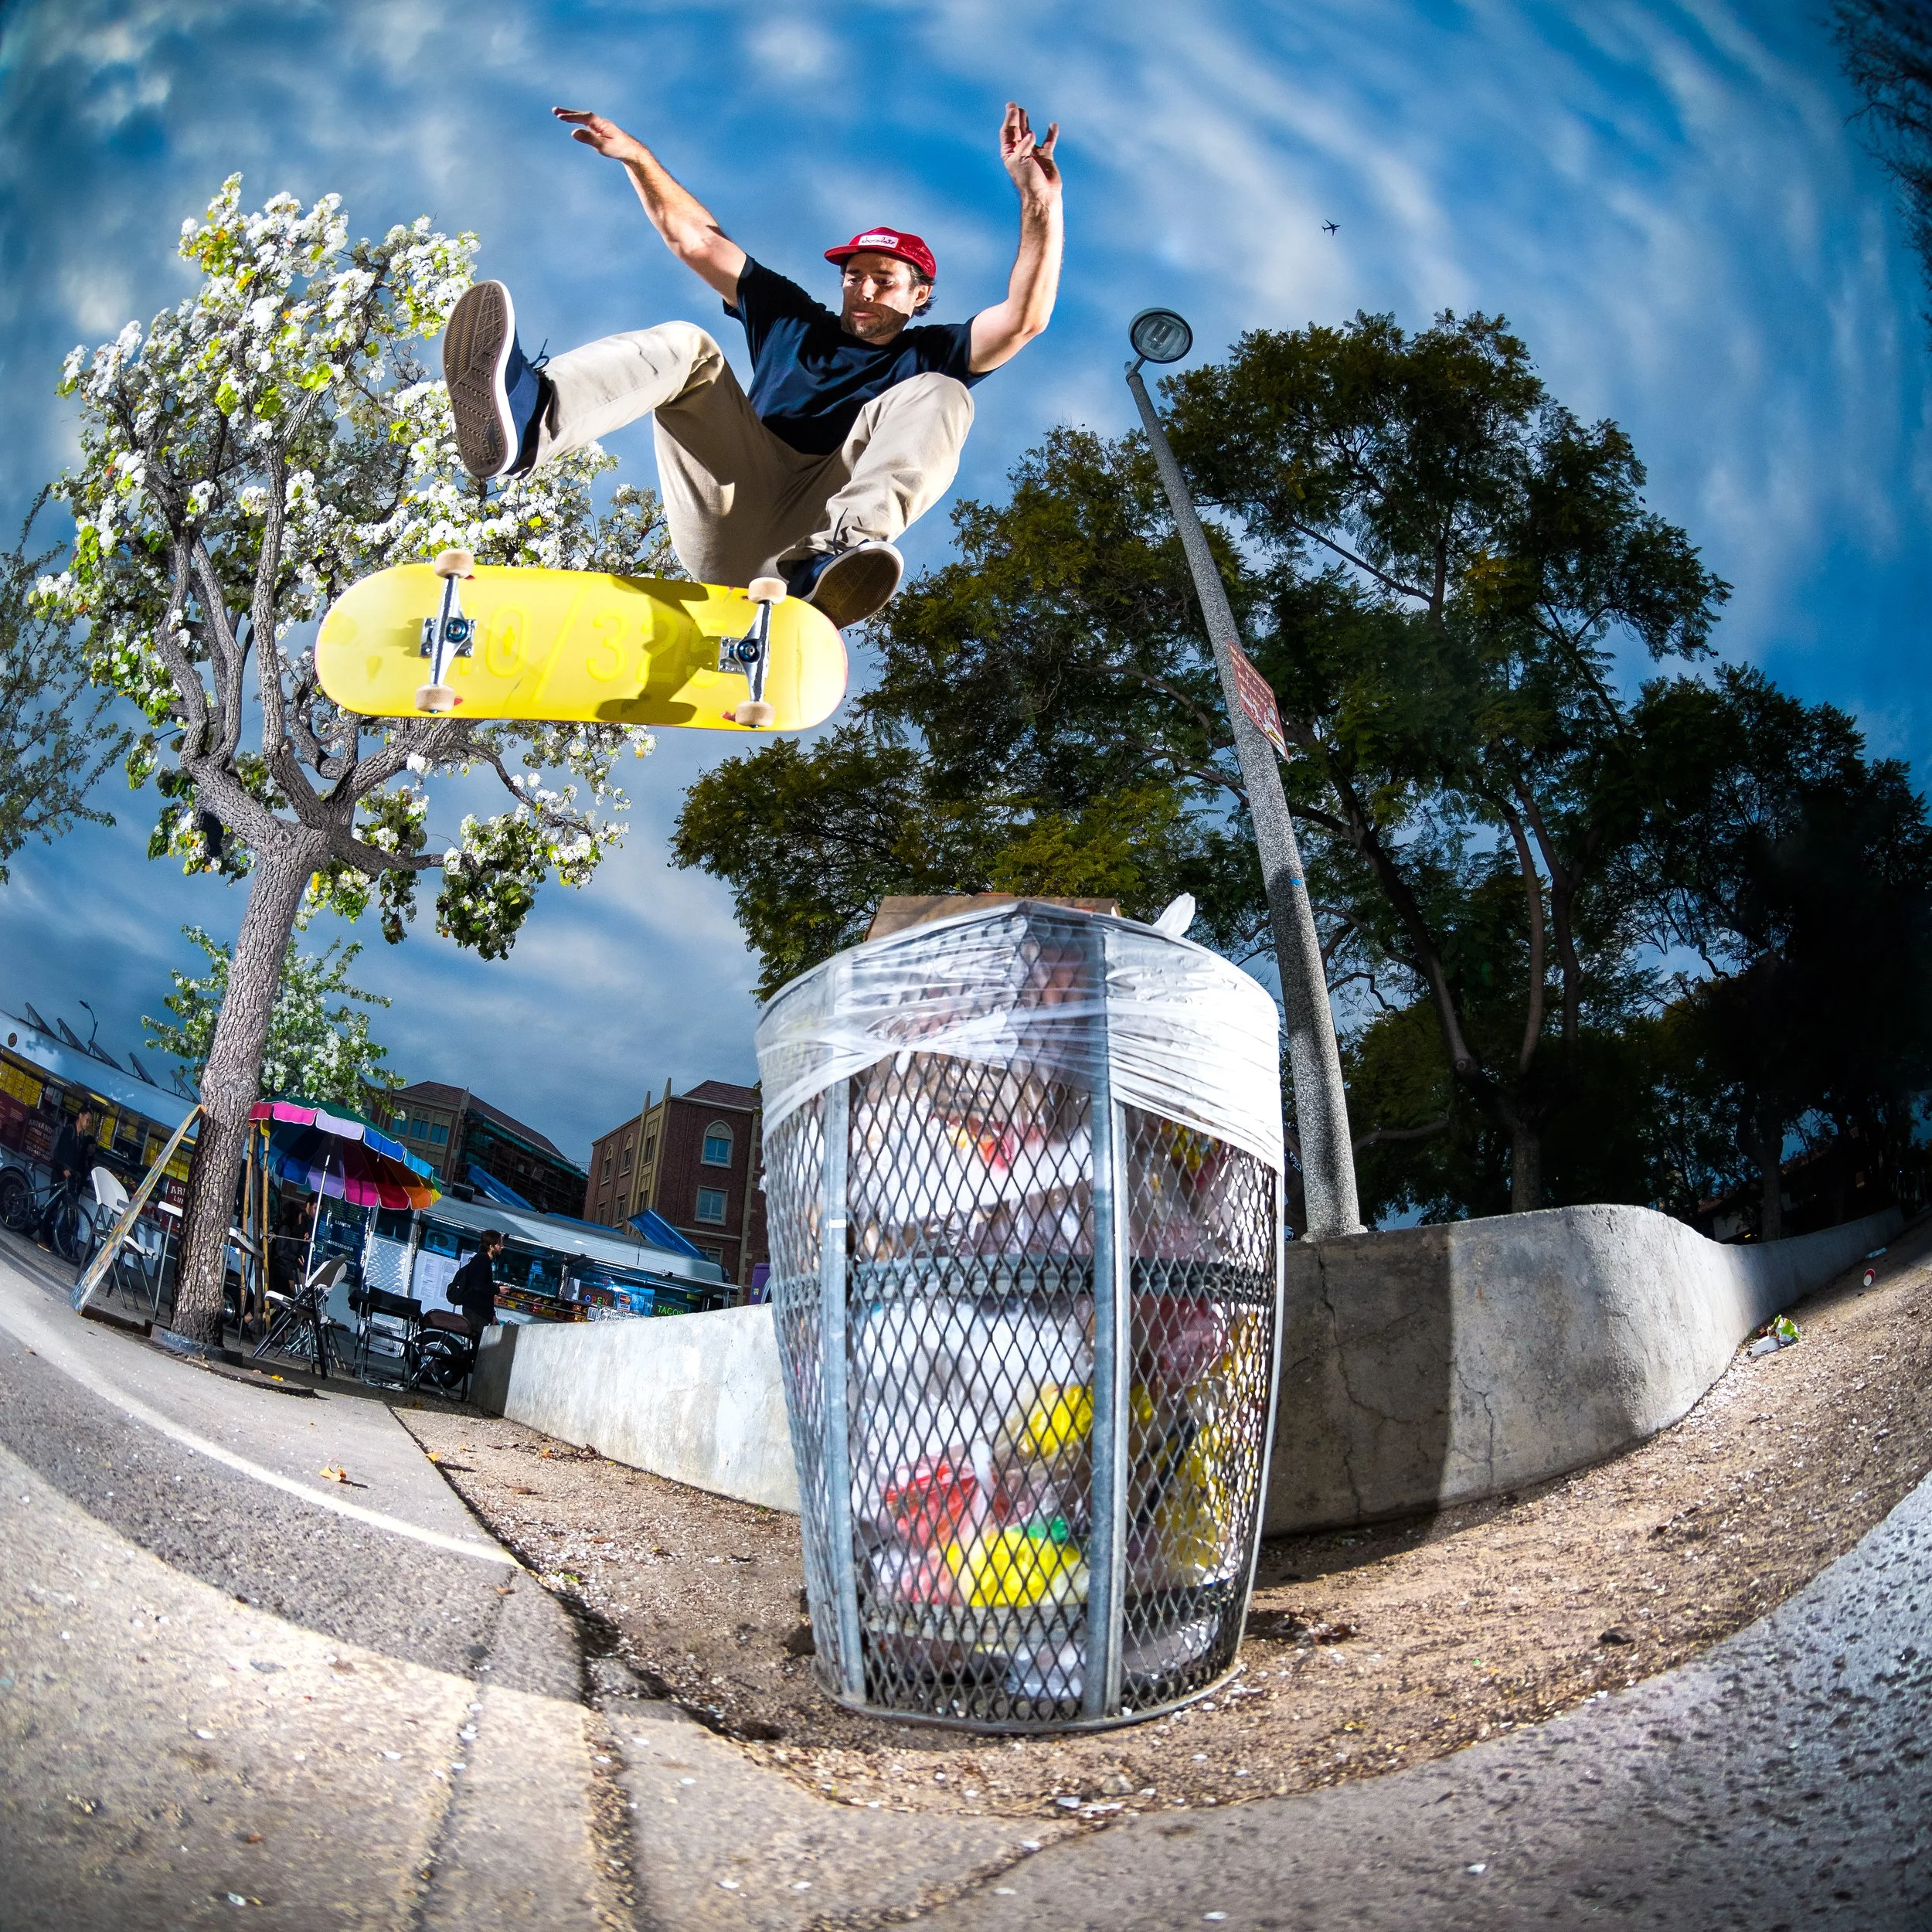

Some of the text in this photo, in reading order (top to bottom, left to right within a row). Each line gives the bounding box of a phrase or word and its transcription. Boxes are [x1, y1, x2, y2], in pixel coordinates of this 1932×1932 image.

[861, 236, 896, 245] chocolate
[327, 1240, 354, 1251] AMBURGER
[585, 1294, 608, 1306] OPEN
